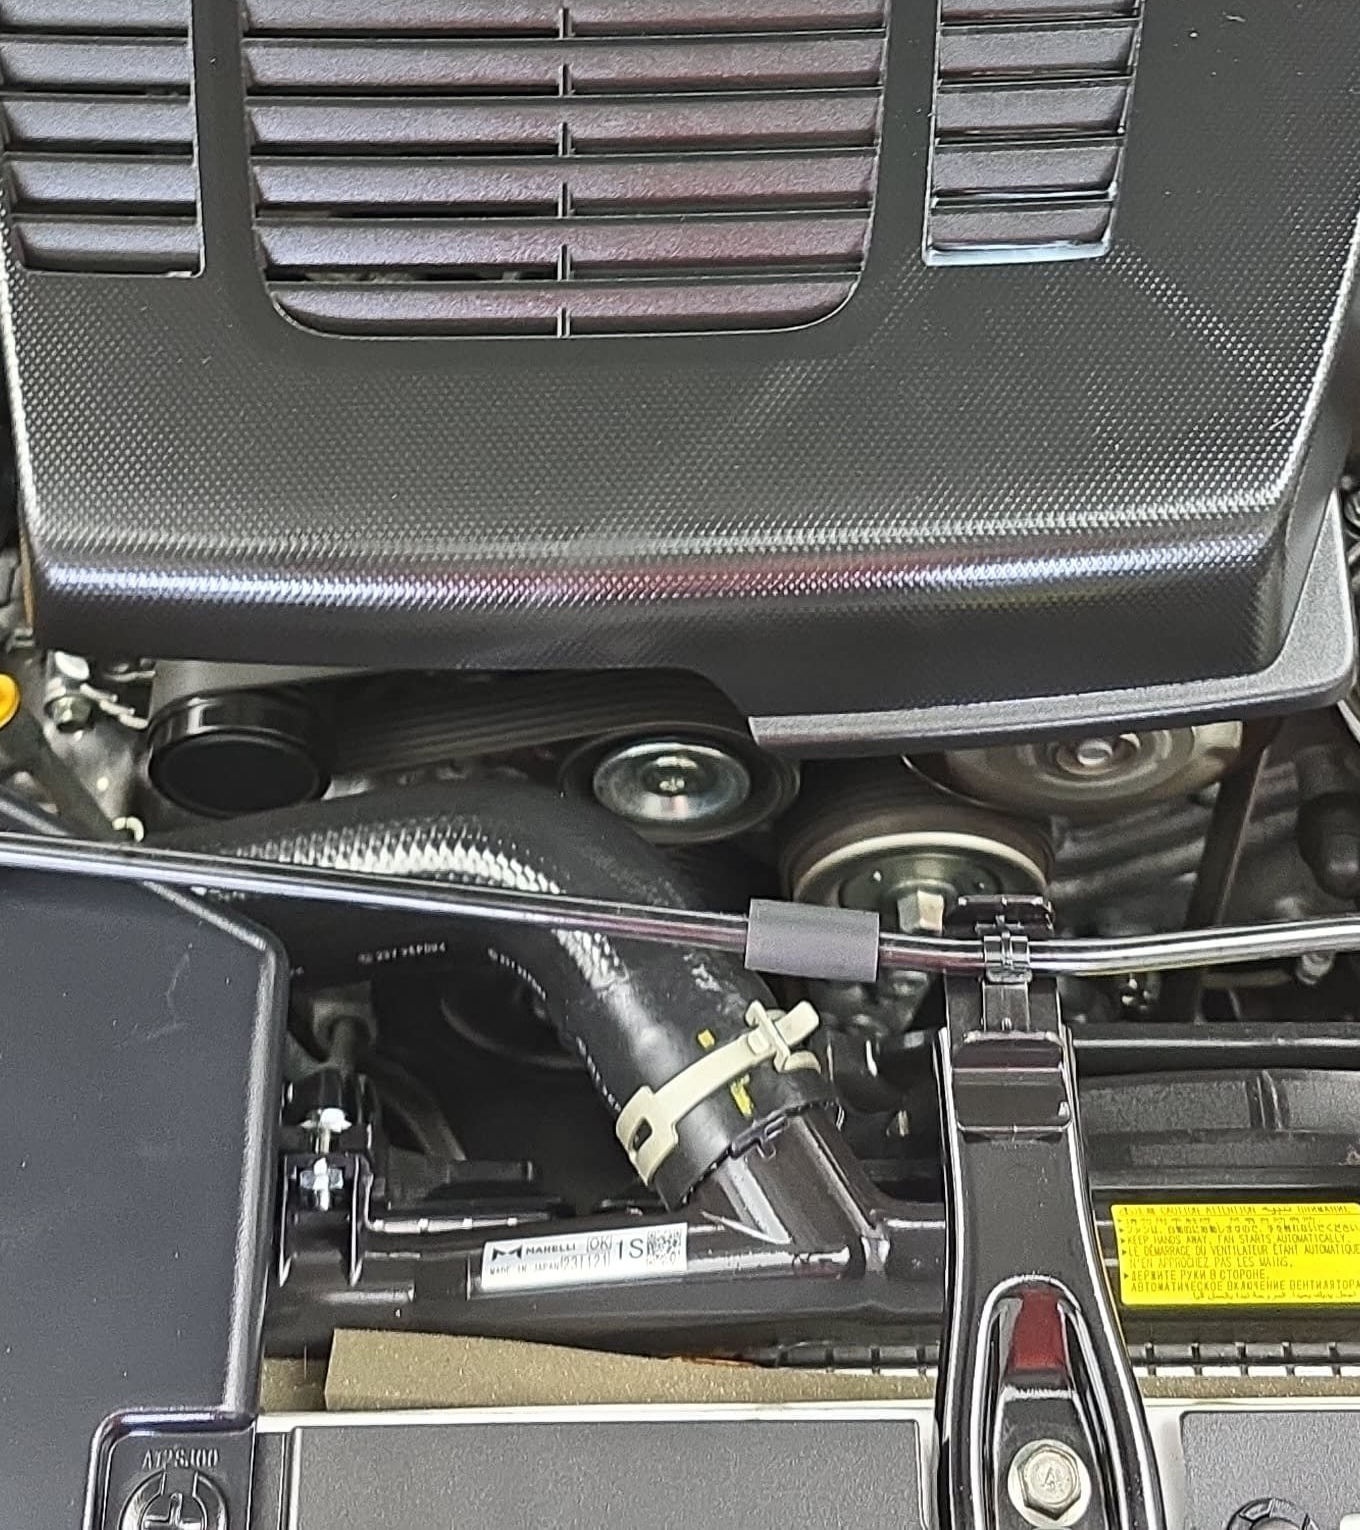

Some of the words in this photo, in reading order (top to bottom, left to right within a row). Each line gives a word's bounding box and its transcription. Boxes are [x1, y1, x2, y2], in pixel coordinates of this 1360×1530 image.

[526, 1243, 576, 1255] MARELLI
[589, 1236, 611, 1251] OK
[618, 1237, 644, 1260] 1S
[1211, 1245, 1268, 1256] VENTILATEUR
[1215, 1257, 1232, 1268] PAS
[1237, 1257, 1254, 1268] LES
[1131, 1270, 1177, 1281] ДЕРЖИТЕ
[1181, 1269, 1206, 1280] РУКИ
[1210, 1269, 1217, 1279] В
[1219, 1268, 1270, 1280] СТОРОНЕ.
[1131, 1281, 1224, 1293] АВТОМАТИЧЕСКОЕ
[1227, 1279, 1287, 1291] ВКЛЮЧЕНИЕ
